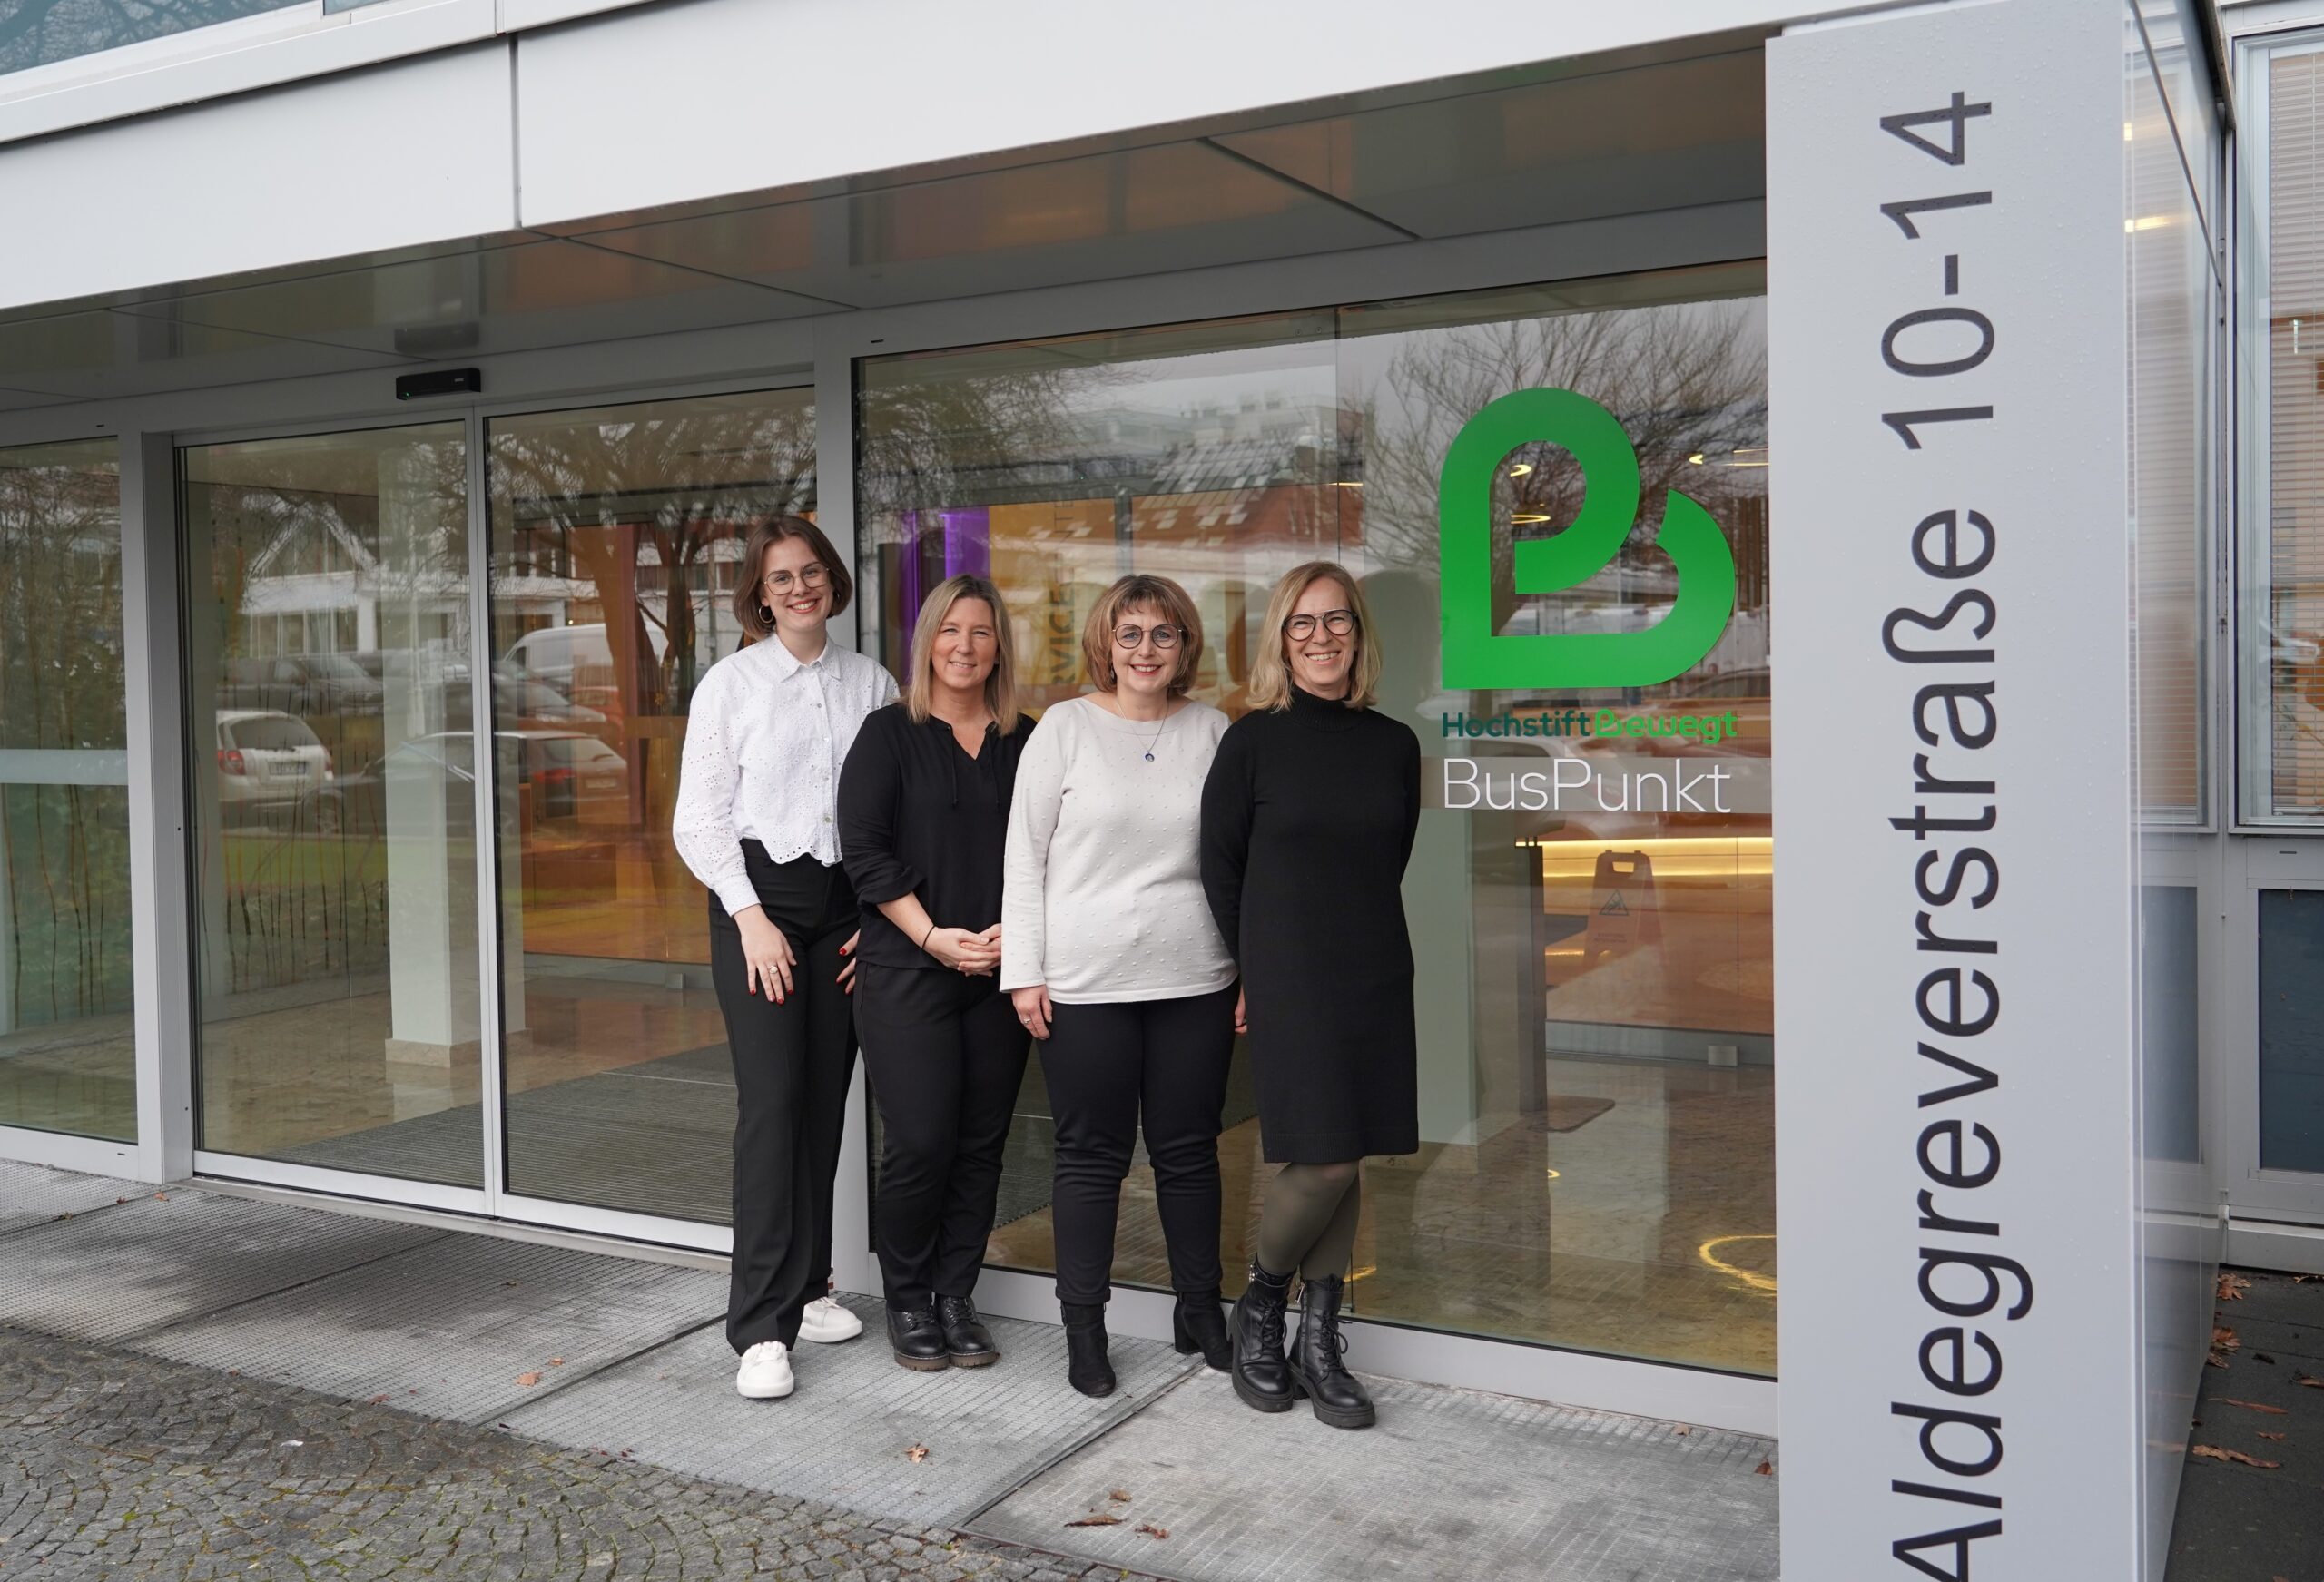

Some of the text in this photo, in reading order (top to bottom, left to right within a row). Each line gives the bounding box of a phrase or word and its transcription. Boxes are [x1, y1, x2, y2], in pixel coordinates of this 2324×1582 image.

[1443, 758, 1731, 813] BusPunkt
[1880, 91, 2034, 1582] Aldegreverstraße 10-14
